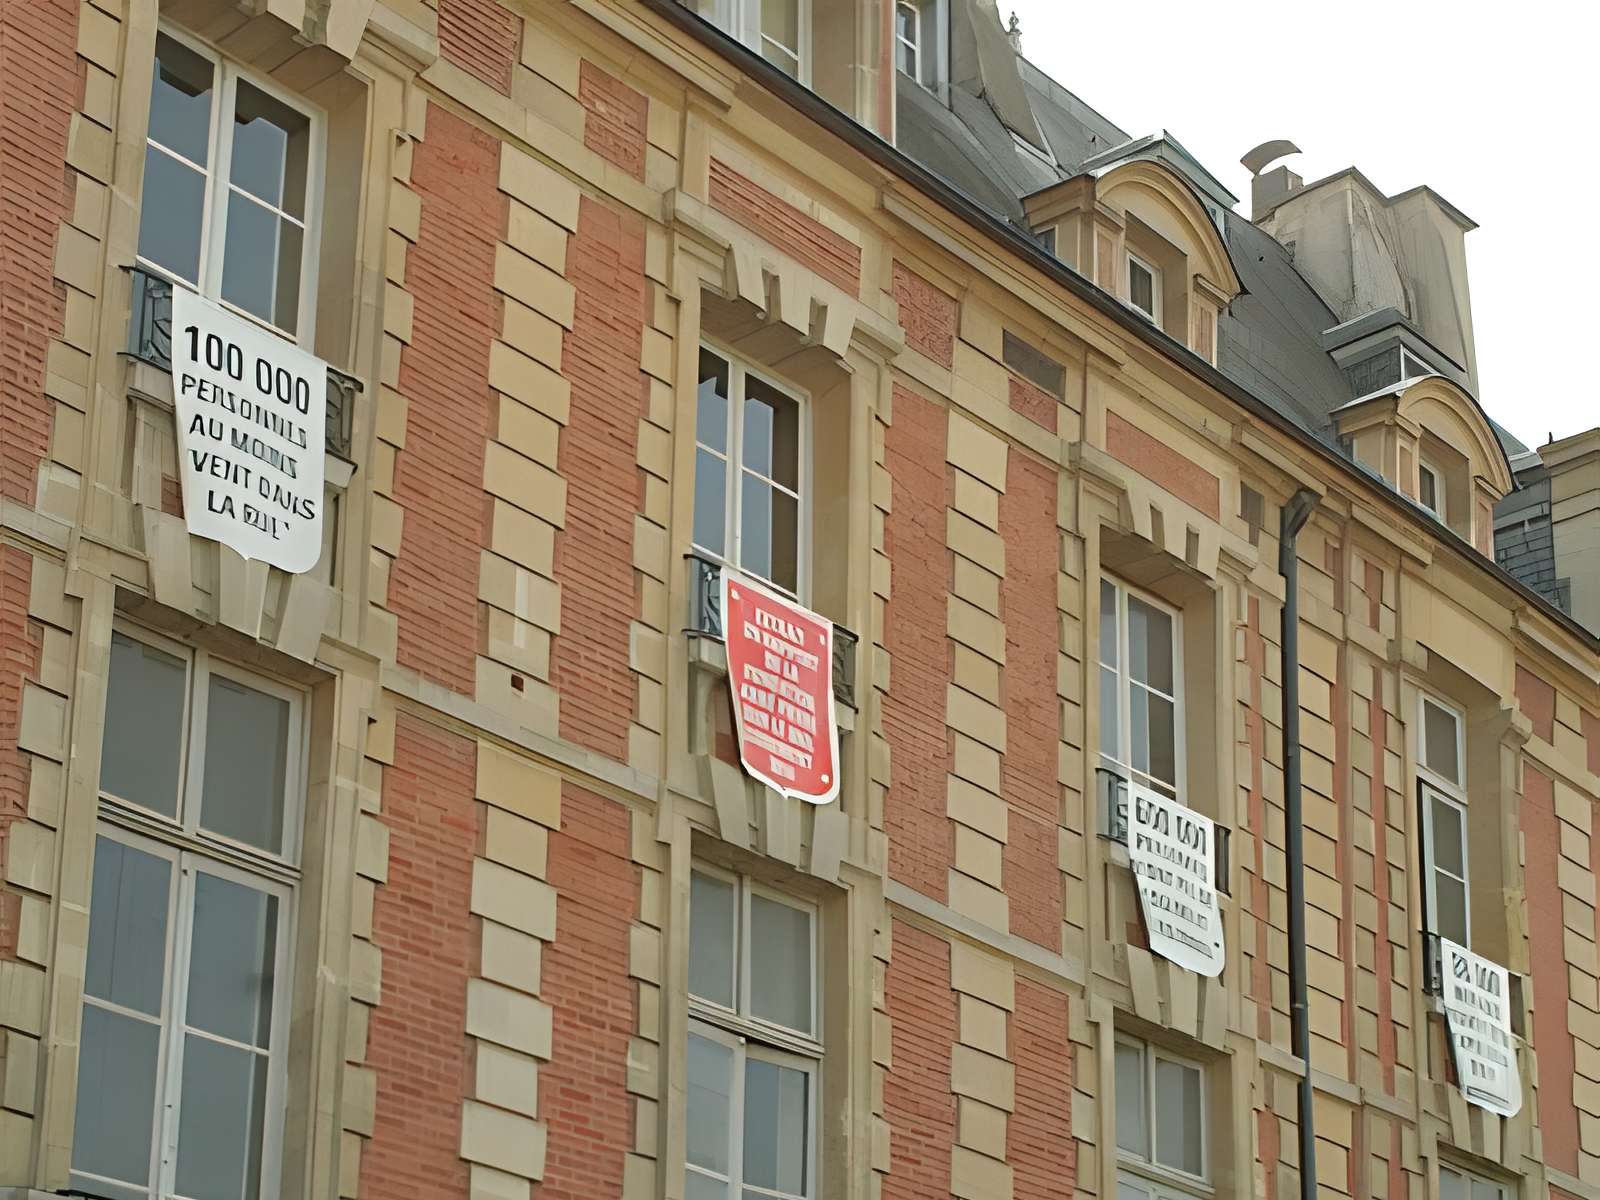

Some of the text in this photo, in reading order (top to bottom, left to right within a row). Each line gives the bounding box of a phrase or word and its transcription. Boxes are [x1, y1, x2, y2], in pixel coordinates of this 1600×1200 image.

[185, 326, 310, 415] 100 000
[189, 414, 223, 441] AU
[208, 490, 236, 519] LA
